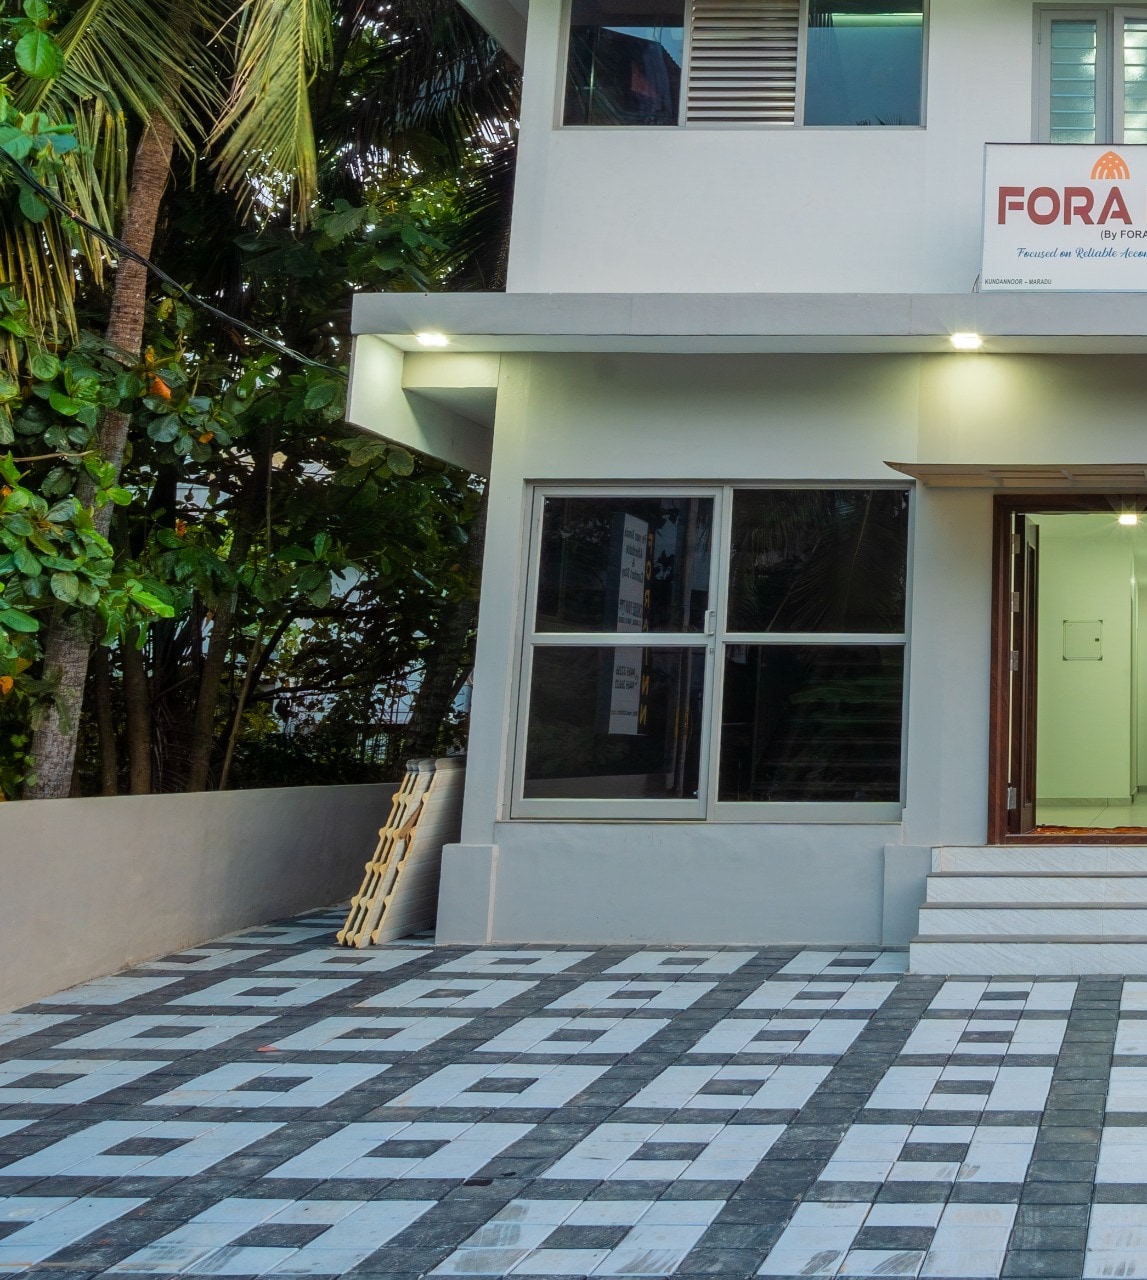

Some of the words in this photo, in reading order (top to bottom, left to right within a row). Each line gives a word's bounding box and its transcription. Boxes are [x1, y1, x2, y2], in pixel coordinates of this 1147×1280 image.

[997, 186, 1133, 226] FORA
[1100, 229, 1117, 241] (By
[1016, 247, 1058, 259] Focused
[1059, 250, 1072, 258] on
[1075, 246, 1118, 259] Reliable
